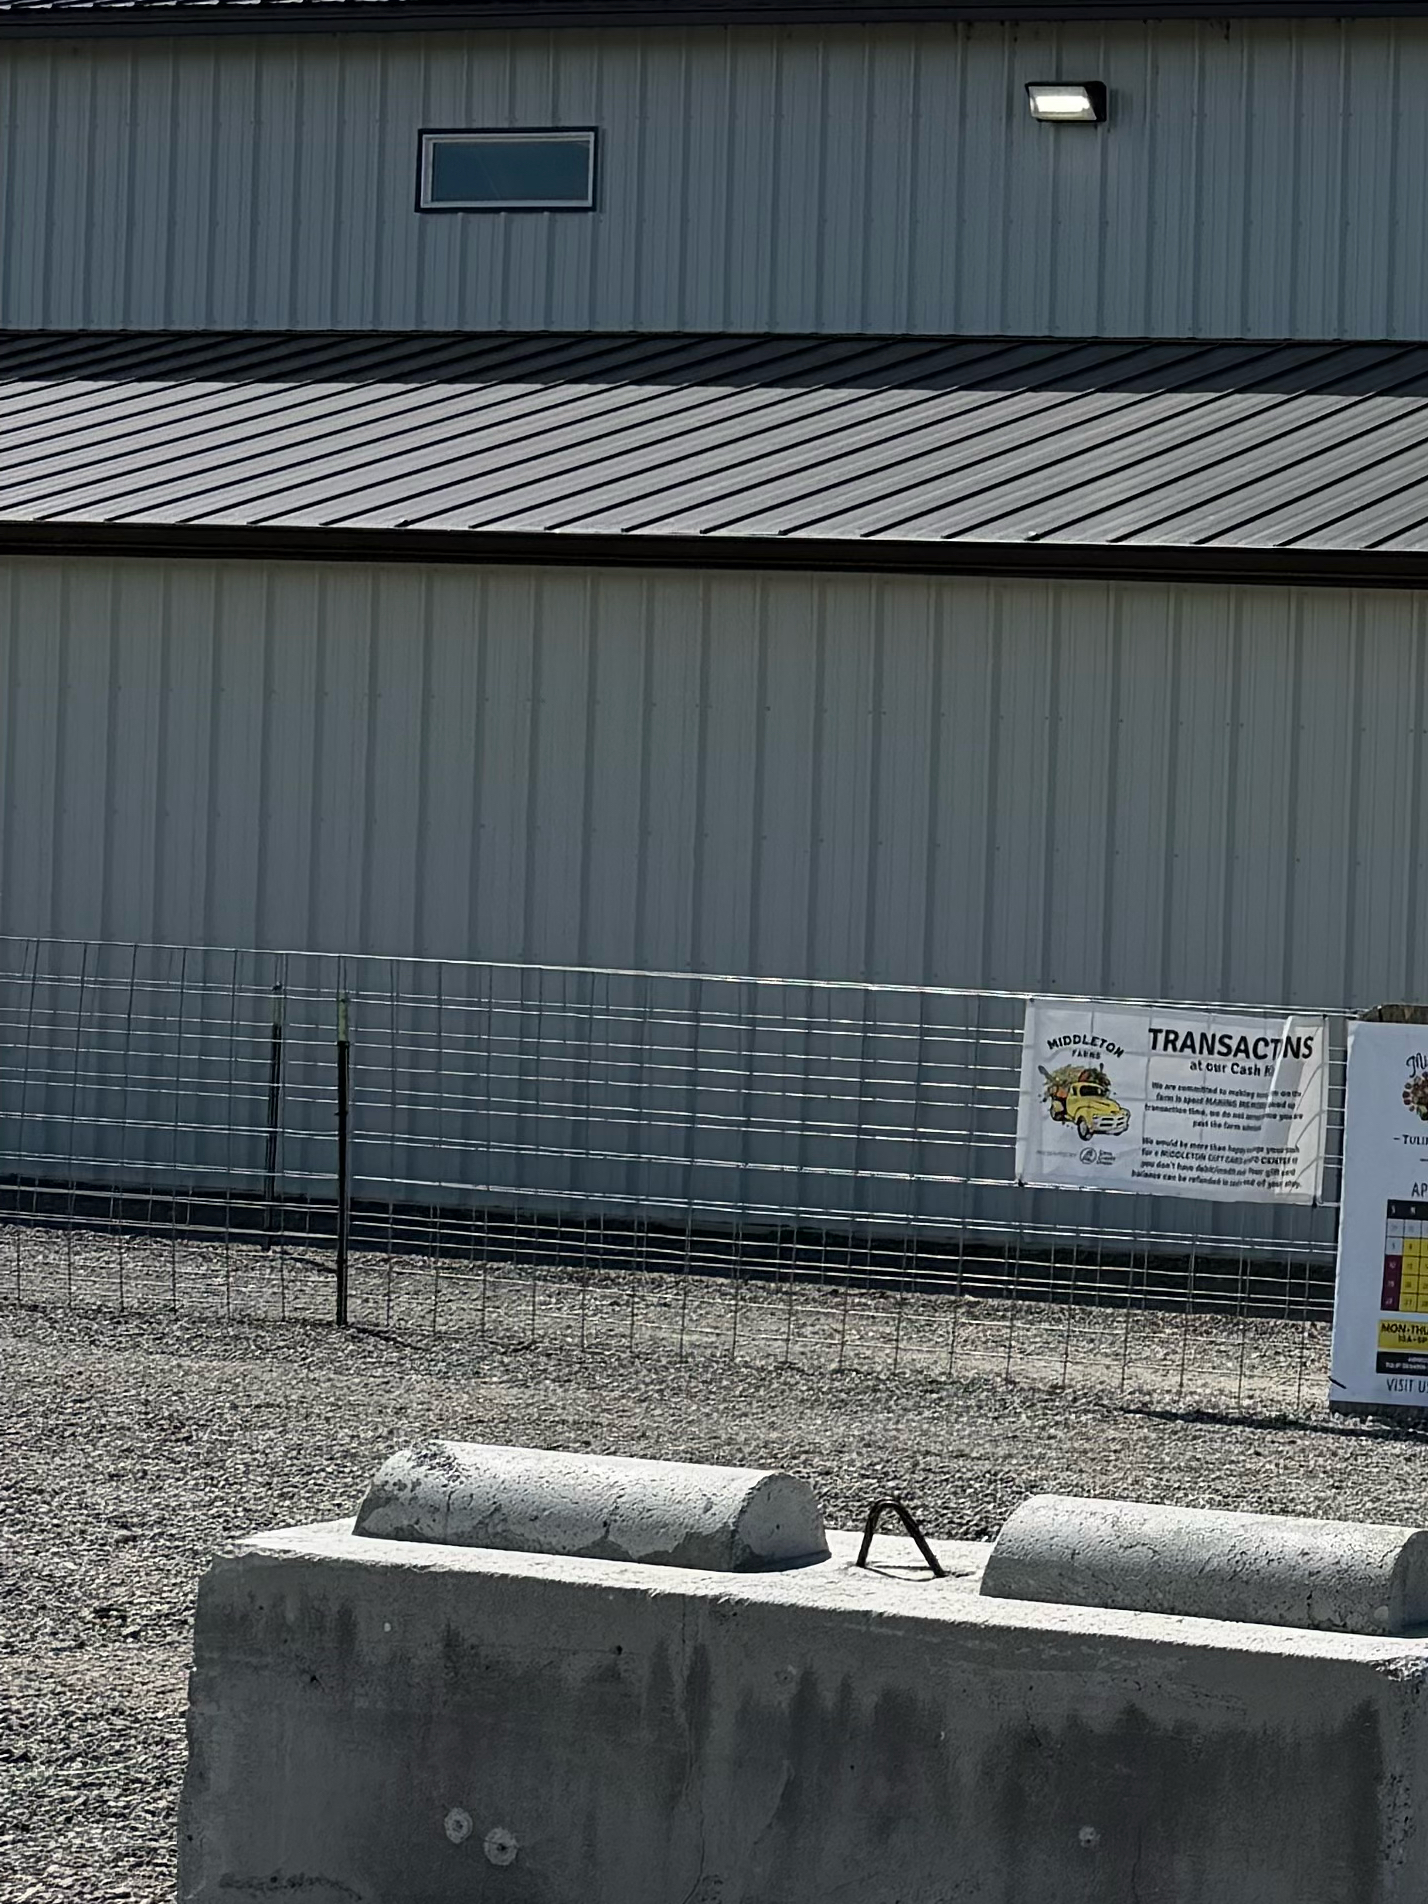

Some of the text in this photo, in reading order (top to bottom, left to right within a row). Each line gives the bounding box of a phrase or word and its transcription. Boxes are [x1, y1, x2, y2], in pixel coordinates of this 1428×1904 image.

[1047, 1034, 1125, 1058] MIDDLETON
[1189, 1059, 1203, 1072] at
[1206, 1062, 1228, 1074] our
[1230, 1062, 1261, 1077] Cash
[1386, 1378, 1414, 1393] VISIT
